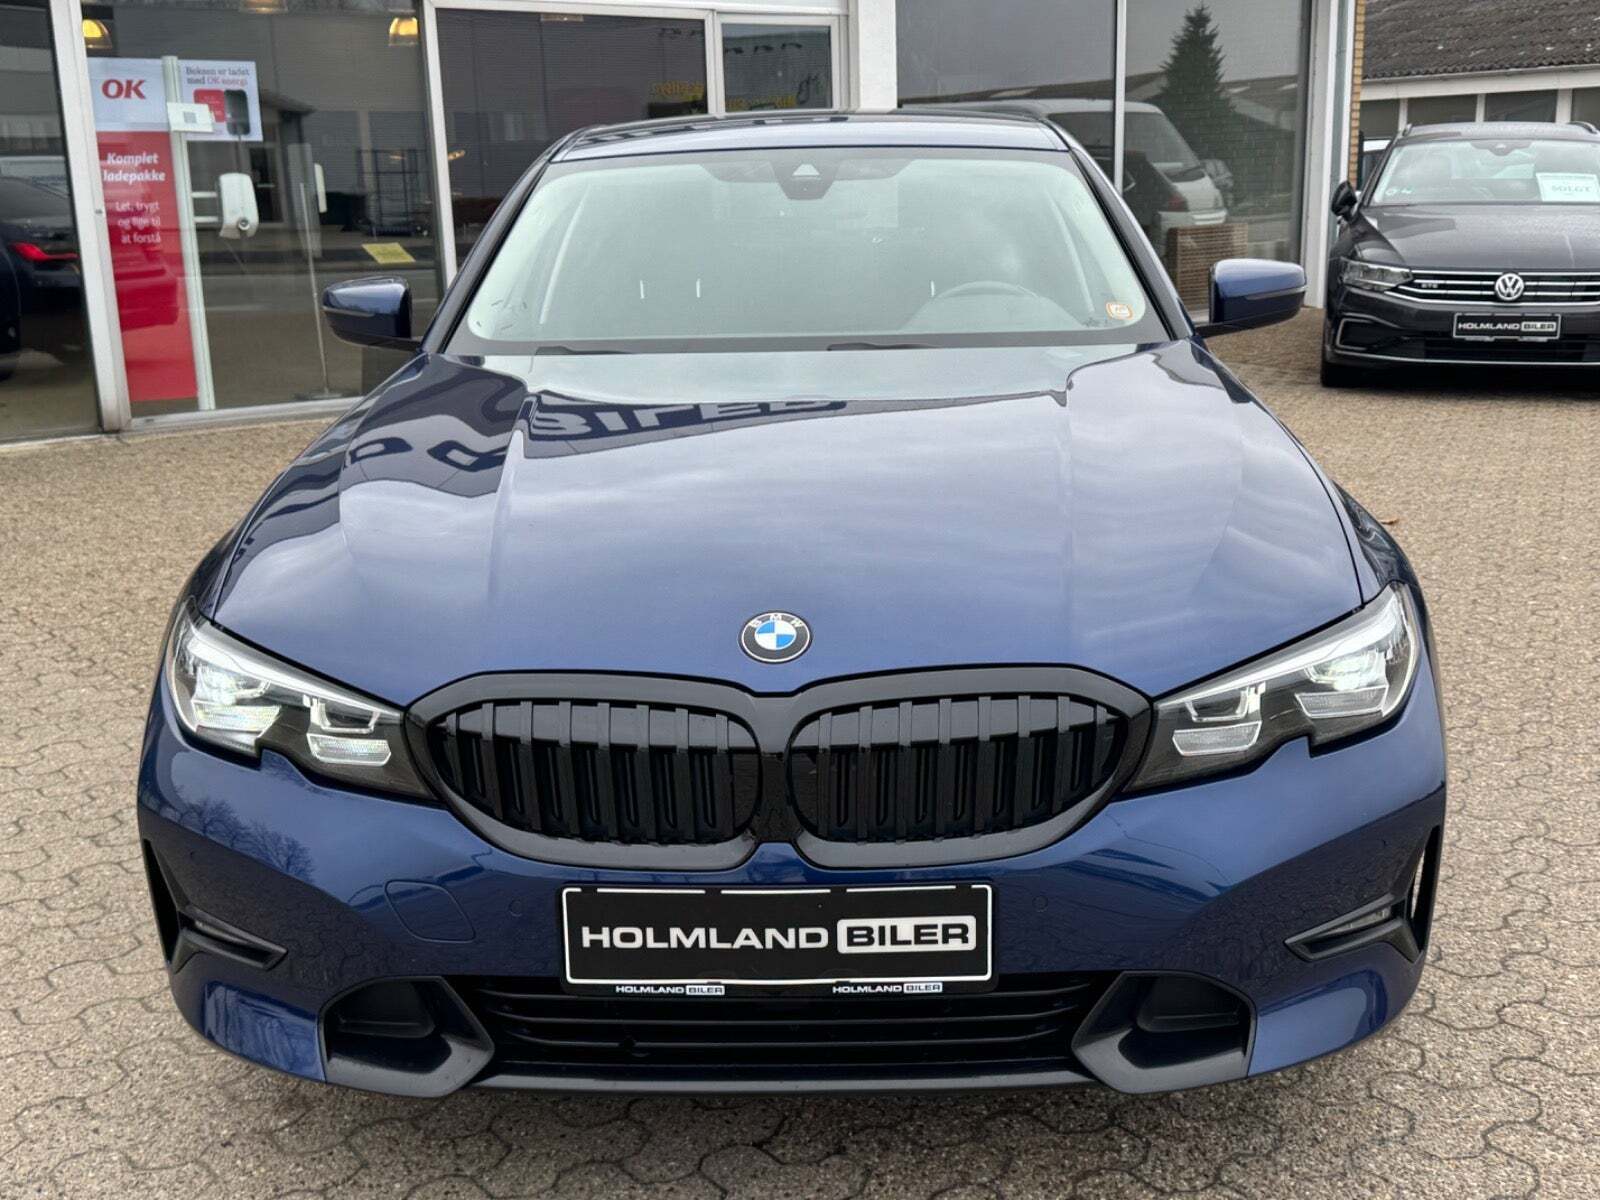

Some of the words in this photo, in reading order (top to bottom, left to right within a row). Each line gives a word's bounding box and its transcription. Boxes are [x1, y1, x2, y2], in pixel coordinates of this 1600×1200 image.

[101, 79, 146, 99] OK
[106, 152, 159, 166] Komplet
[103, 169, 166, 185] ladepakke
[1458, 322, 1520, 330] HOLMLAND
[748, 613, 804, 628] BMW
[582, 926, 828, 949] HOLMLAND
[846, 923, 969, 947] BILER
[615, 985, 685, 994] HOLMLAND
[688, 986, 723, 994] BILER
[832, 984, 903, 994] HOLMLAND
[906, 984, 940, 992] BILER
